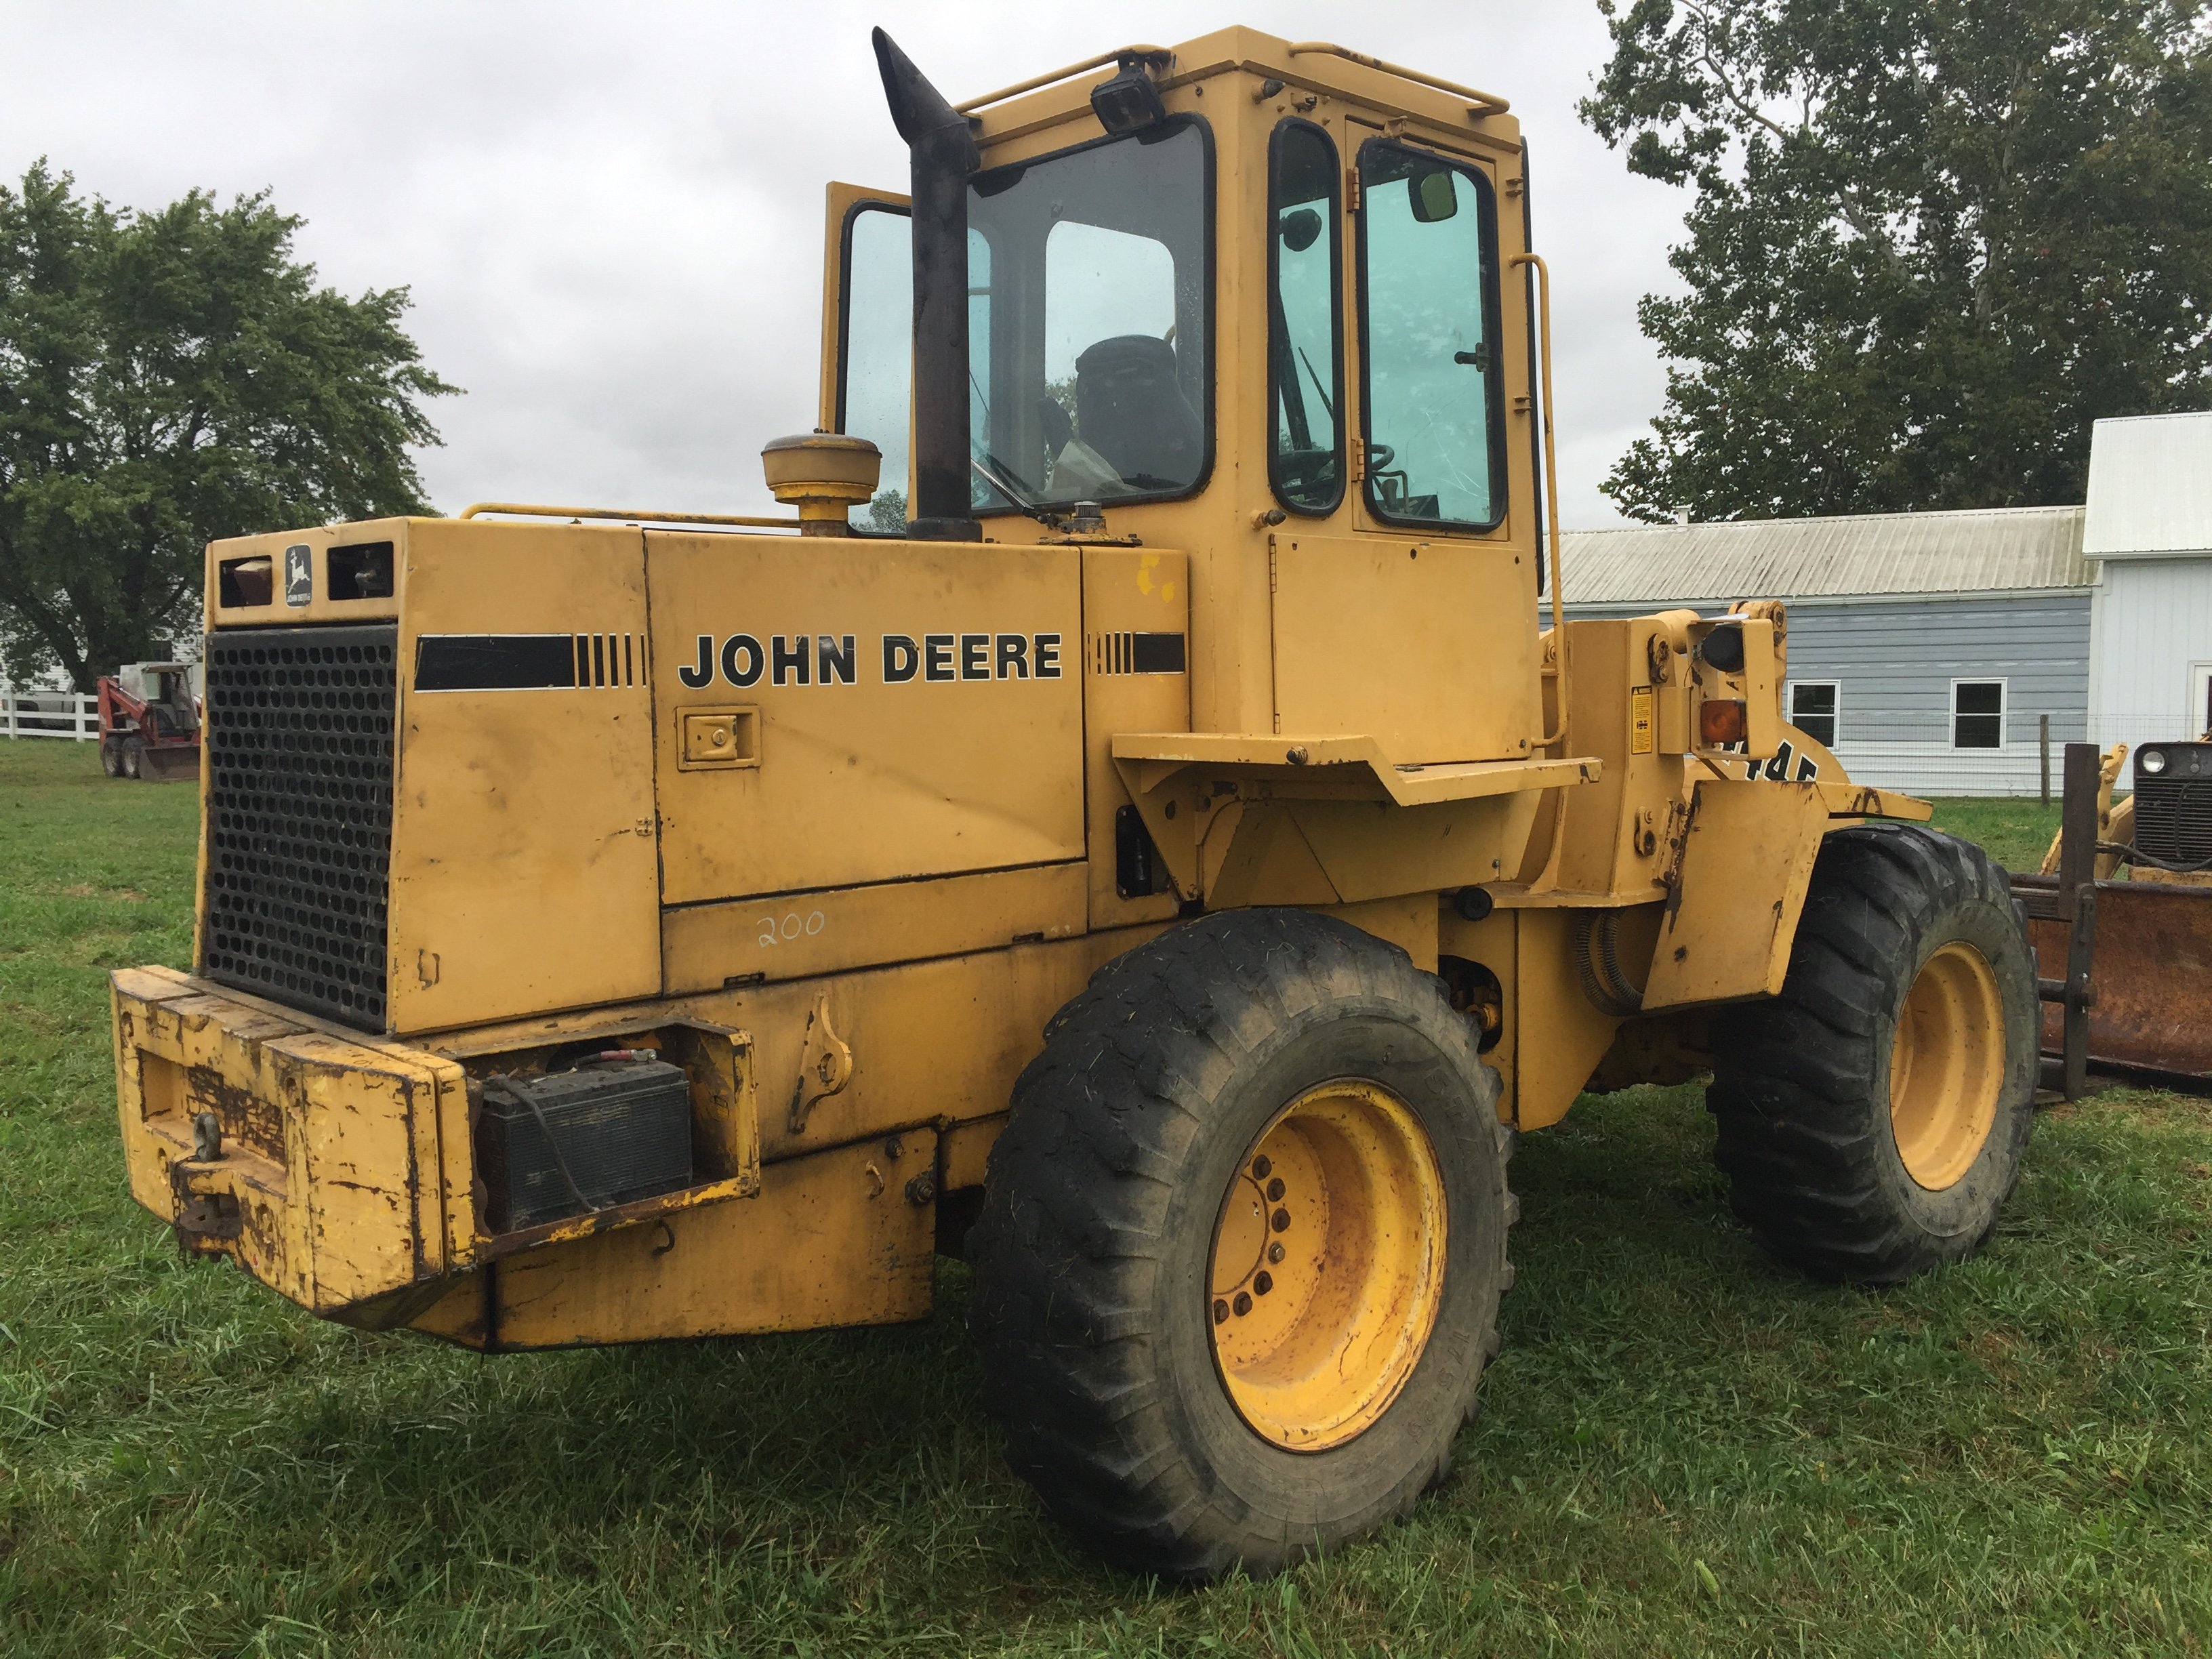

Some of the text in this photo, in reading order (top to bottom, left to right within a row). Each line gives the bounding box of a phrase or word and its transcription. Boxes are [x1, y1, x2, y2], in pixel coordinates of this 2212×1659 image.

[677, 633, 1062, 689] JOHN DEERE
[756, 911, 825, 948] 200
